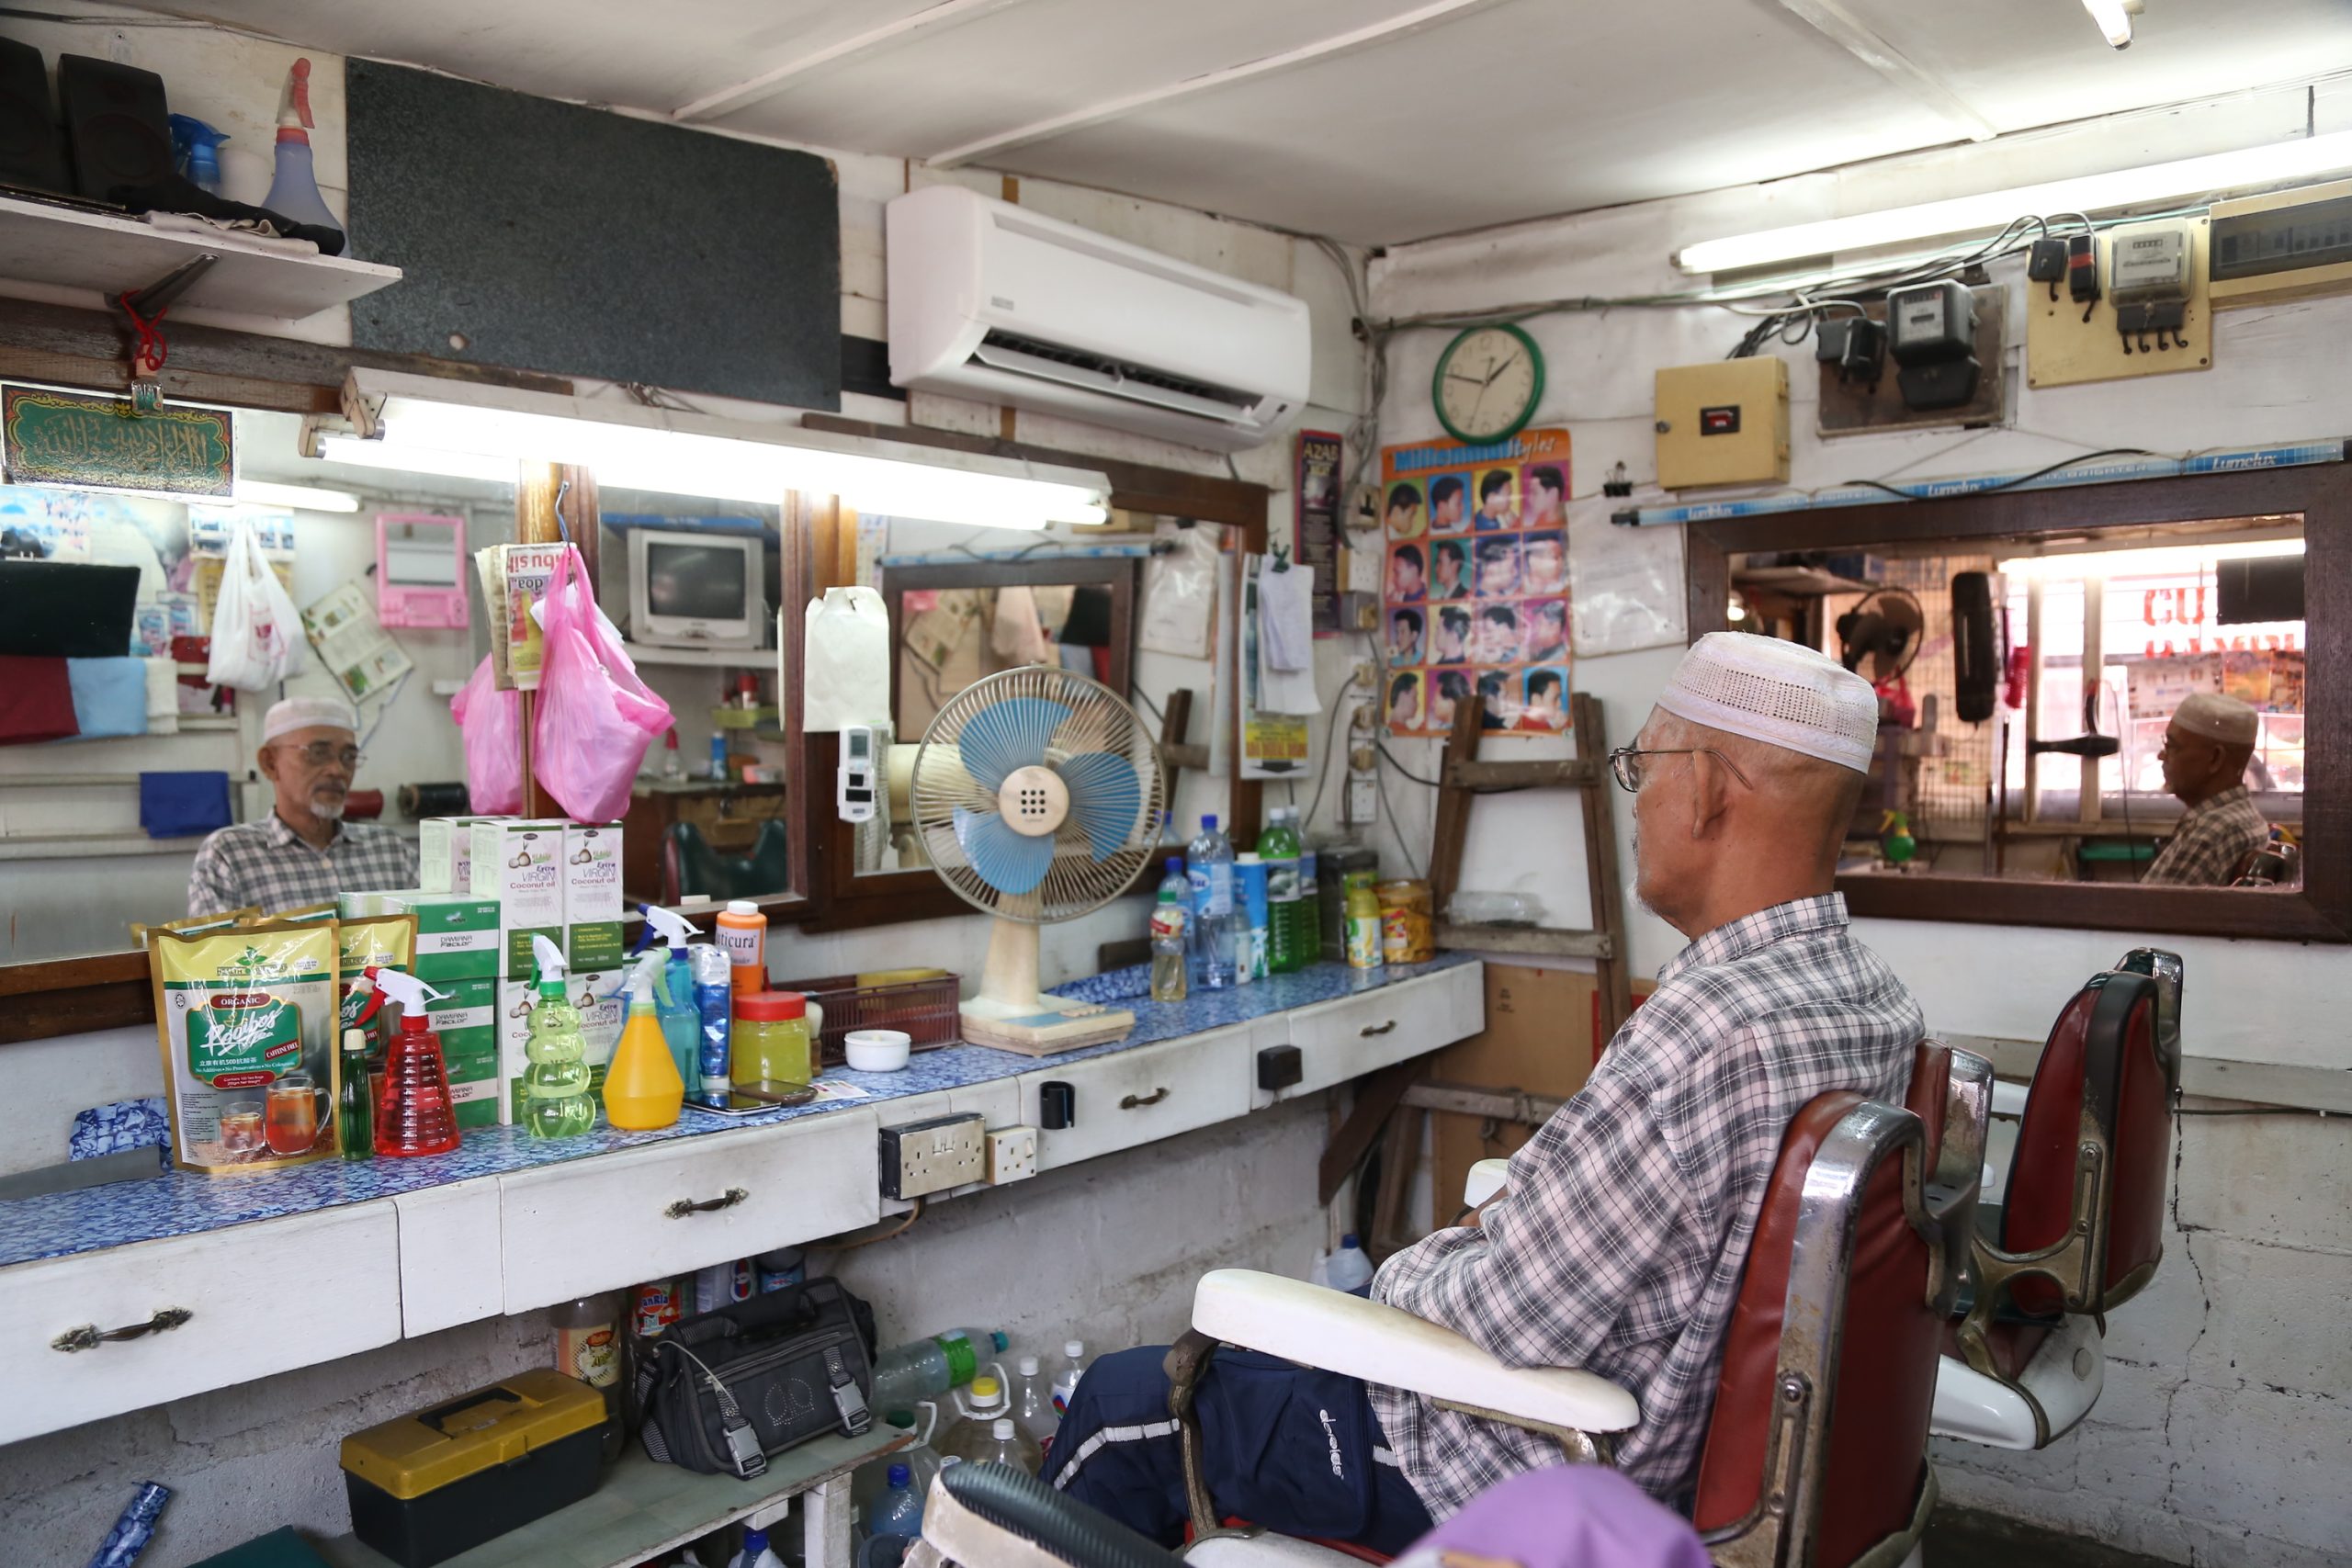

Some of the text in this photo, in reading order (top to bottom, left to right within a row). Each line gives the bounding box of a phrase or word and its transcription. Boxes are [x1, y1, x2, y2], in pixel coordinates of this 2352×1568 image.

[2211, 452, 2278, 471] Lumelux
[1928, 480, 1980, 498] Lumelux
[522, 872, 556, 882] VIRGIN
[583, 867, 616, 878] VIRGIN
[440, 935, 473, 943] DAMIANA
[220, 997, 260, 1006] ORGANIC
[586, 1010, 617, 1022] VIRGIN
[582, 1020, 607, 1029] oconut
[266, 1042, 300, 1059] CAFFEINE FREE
